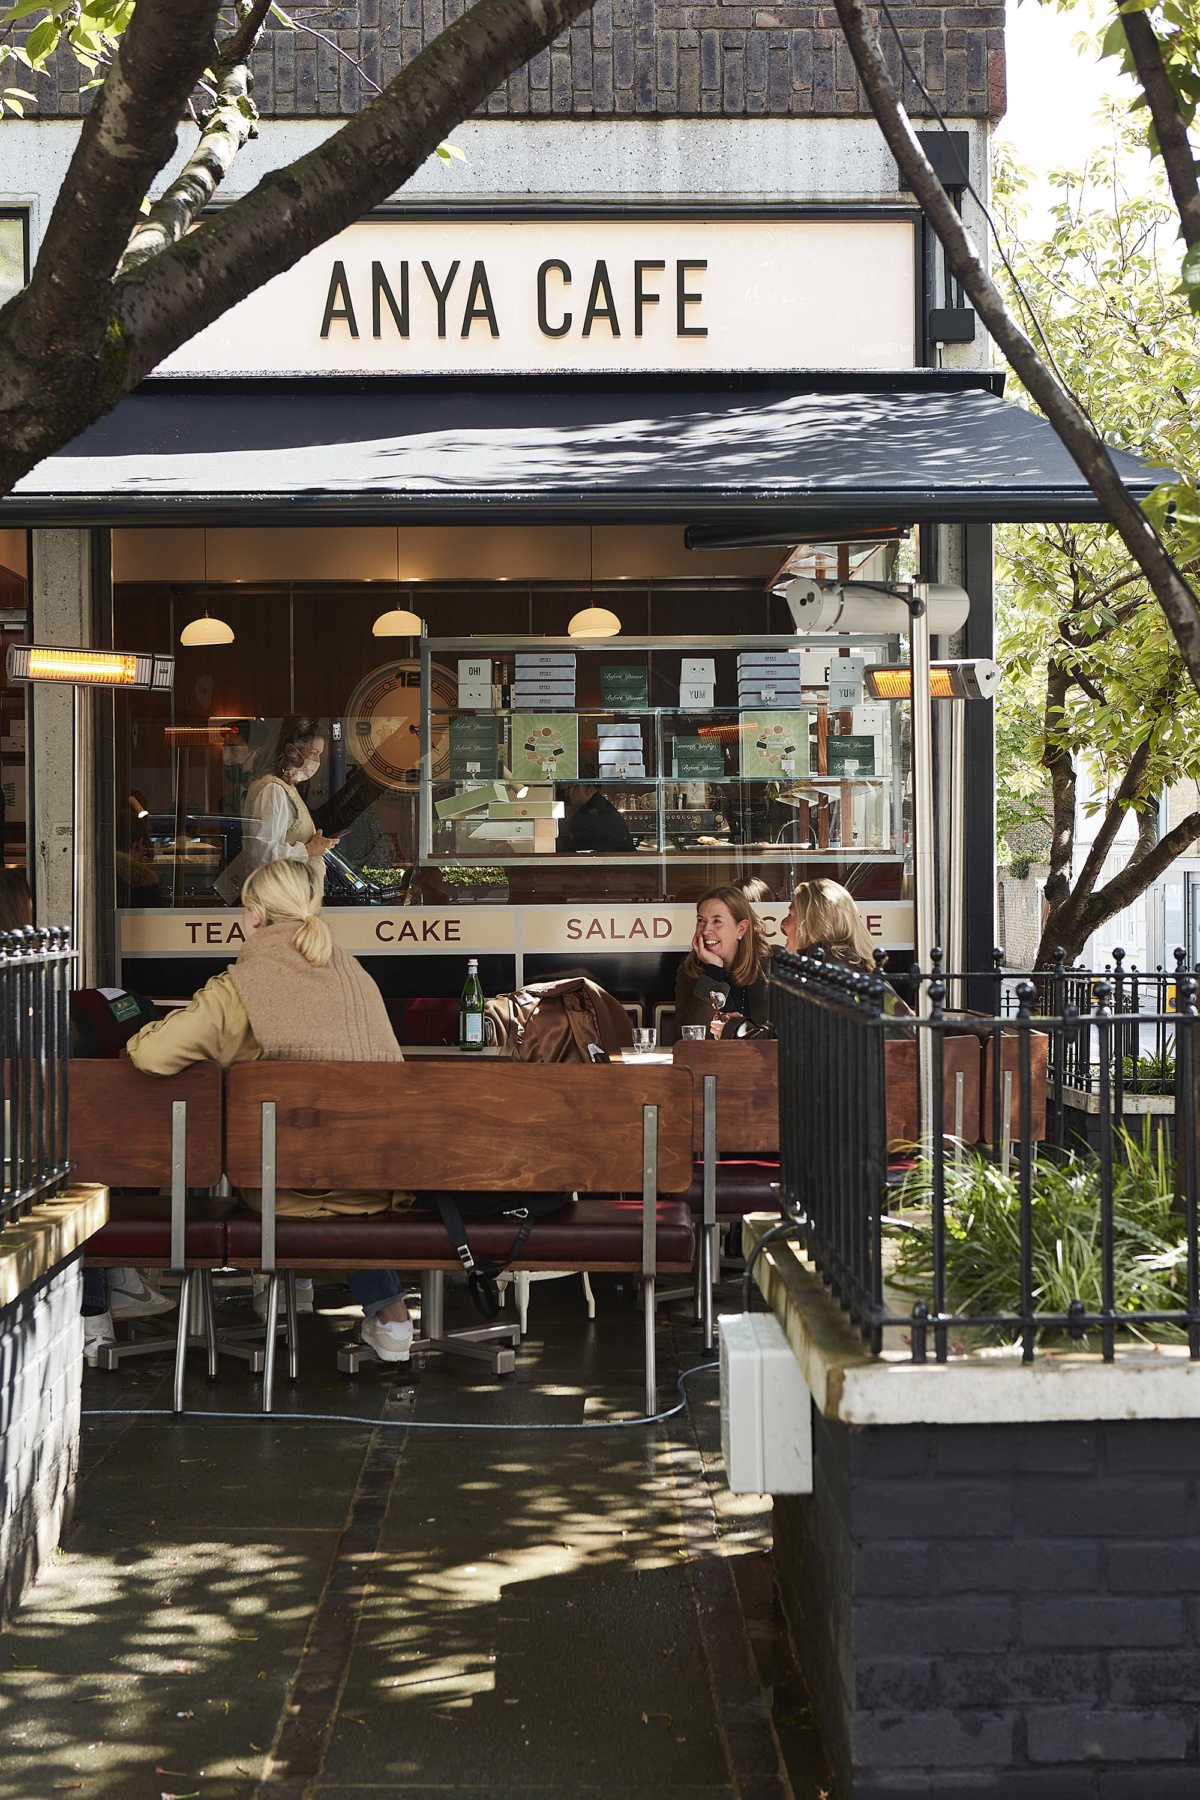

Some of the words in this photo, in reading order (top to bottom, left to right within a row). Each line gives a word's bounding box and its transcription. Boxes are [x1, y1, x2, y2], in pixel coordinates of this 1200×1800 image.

[319, 260, 500, 340] ANYA
[537, 258, 709, 339] CAFE
[468, 666, 481, 676] OH!
[604, 672, 622, 680] Before
[605, 694, 623, 702] Before
[689, 690, 706, 699] YUM
[838, 688, 856, 698] YUM
[185, 922, 246, 944] TEA
[375, 920, 462, 942] CAKE
[566, 917, 673, 940] SALAD
